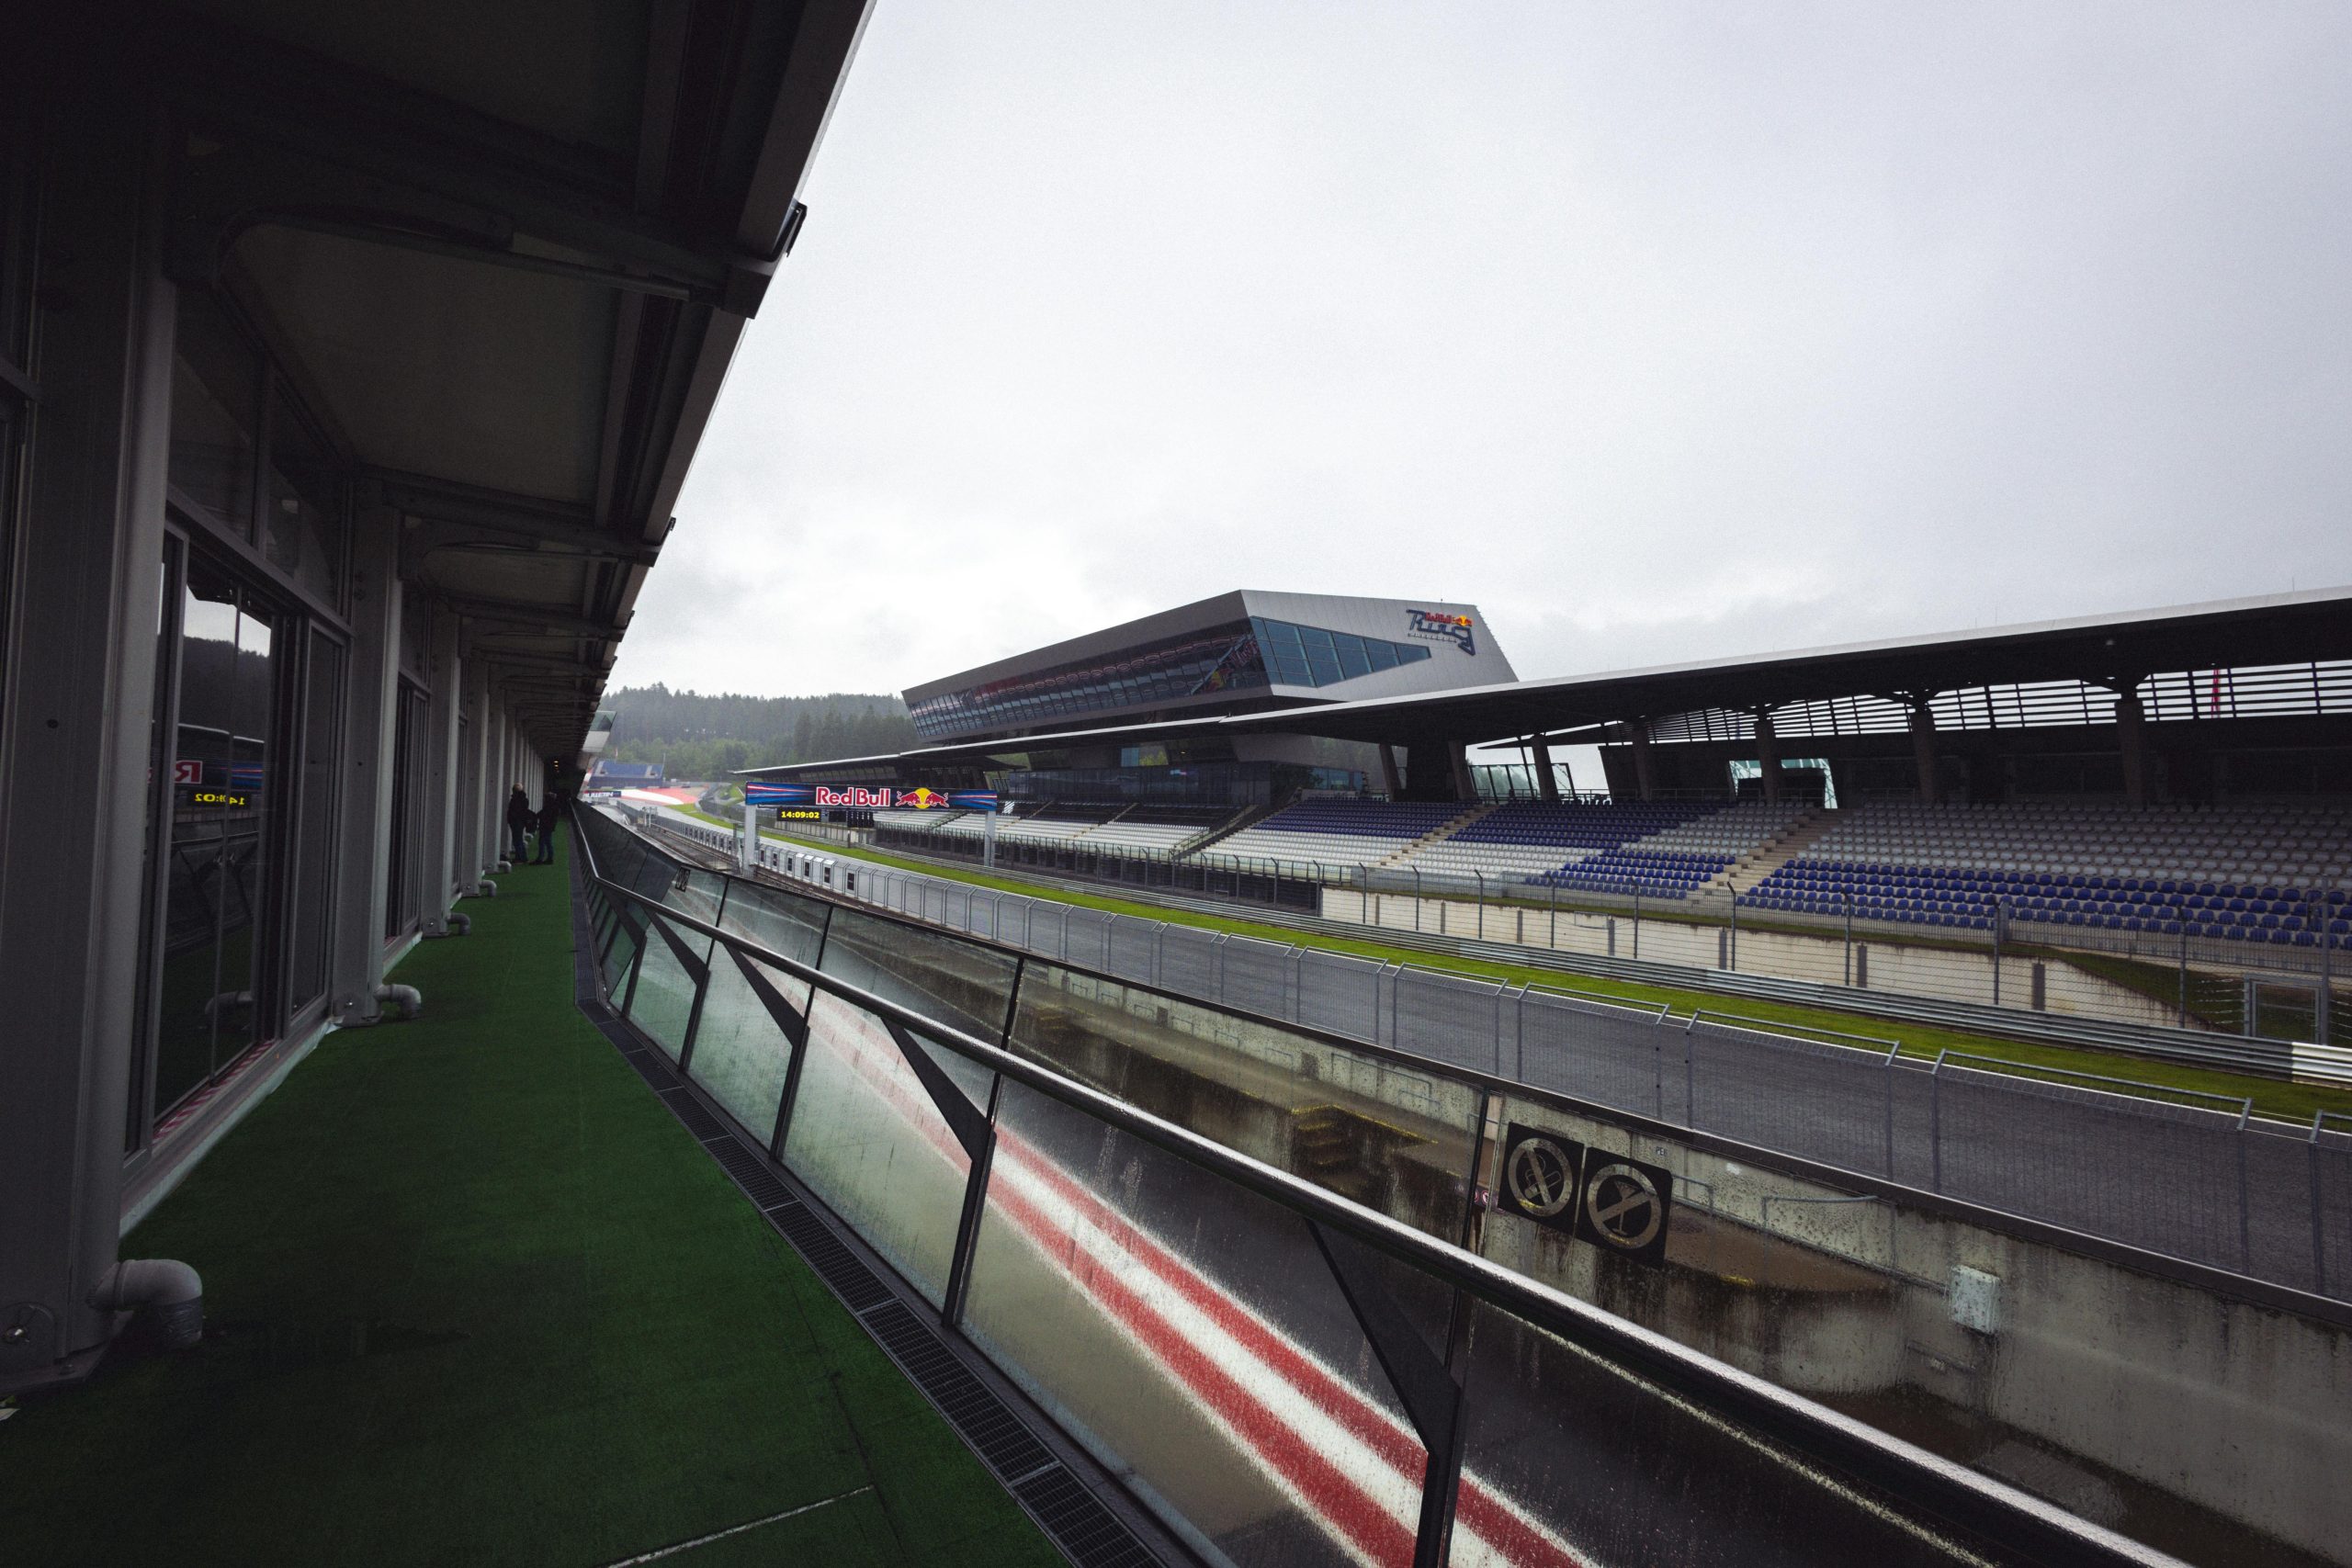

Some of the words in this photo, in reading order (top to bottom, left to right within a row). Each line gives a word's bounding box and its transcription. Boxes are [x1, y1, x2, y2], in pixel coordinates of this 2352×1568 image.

[816, 786, 854, 806] Red
[855, 788, 890, 807] Bull
[781, 811, 820, 819] 14:09:02
